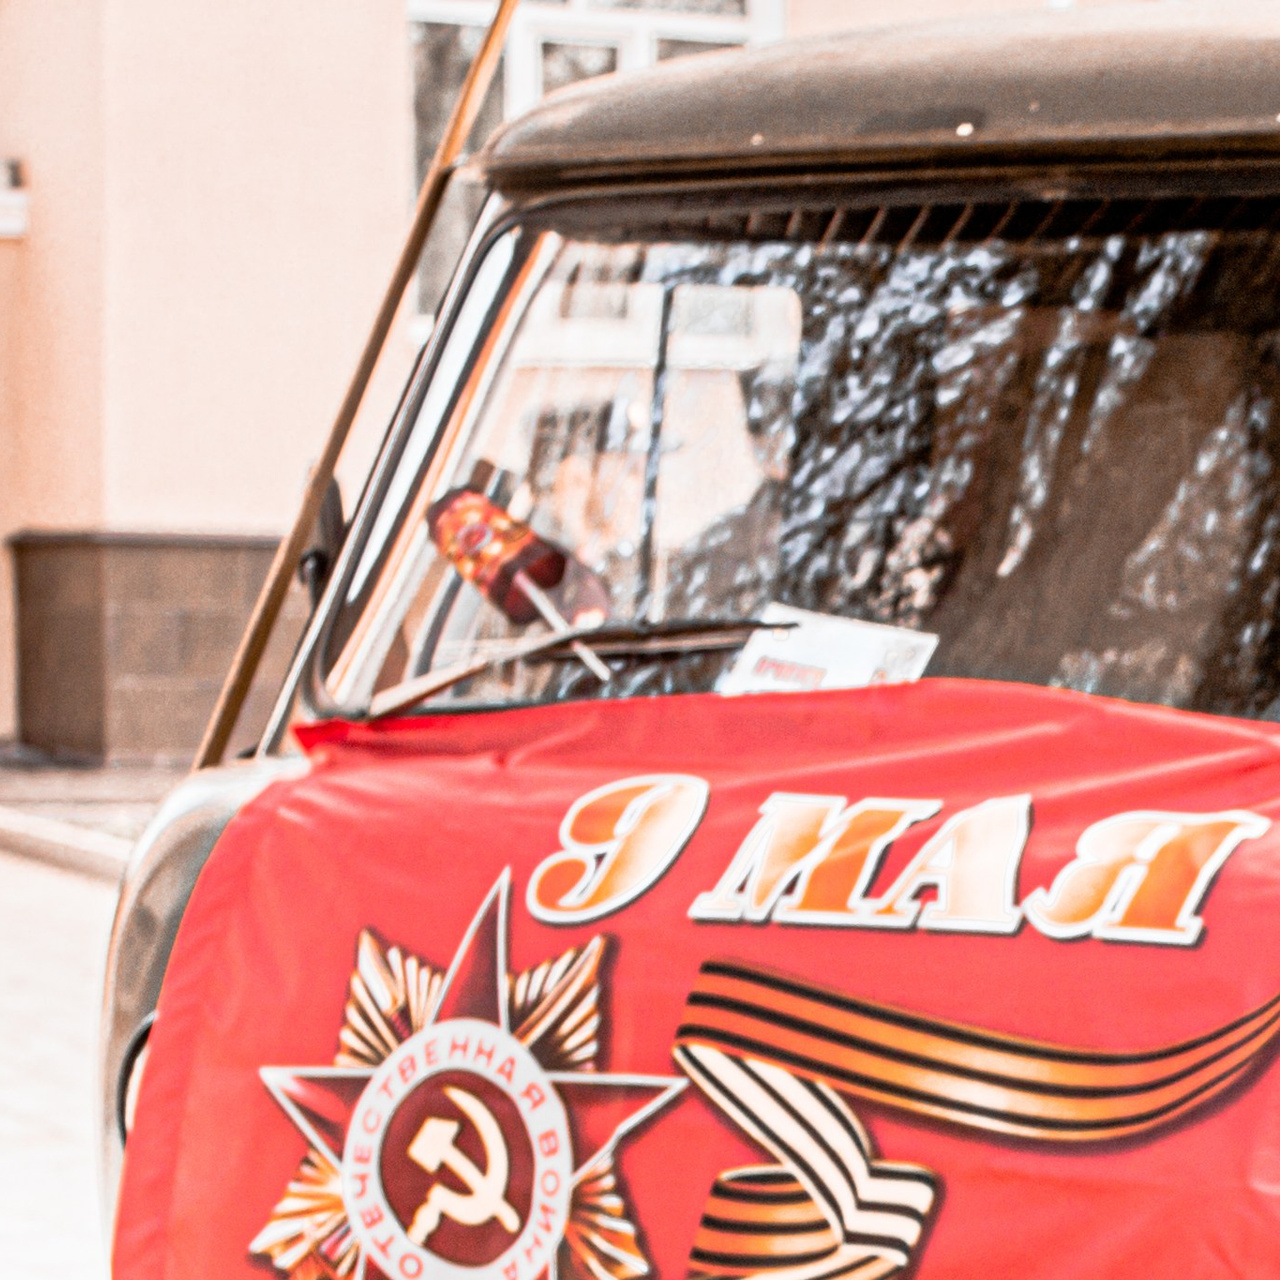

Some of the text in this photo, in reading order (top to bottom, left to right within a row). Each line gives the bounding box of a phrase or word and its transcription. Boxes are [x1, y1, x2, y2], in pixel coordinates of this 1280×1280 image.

[526, 774, 1272, 946] 9 МАЯ
[352, 1036, 546, 1280] ОТЕЧЕСТВЕННАЯ
